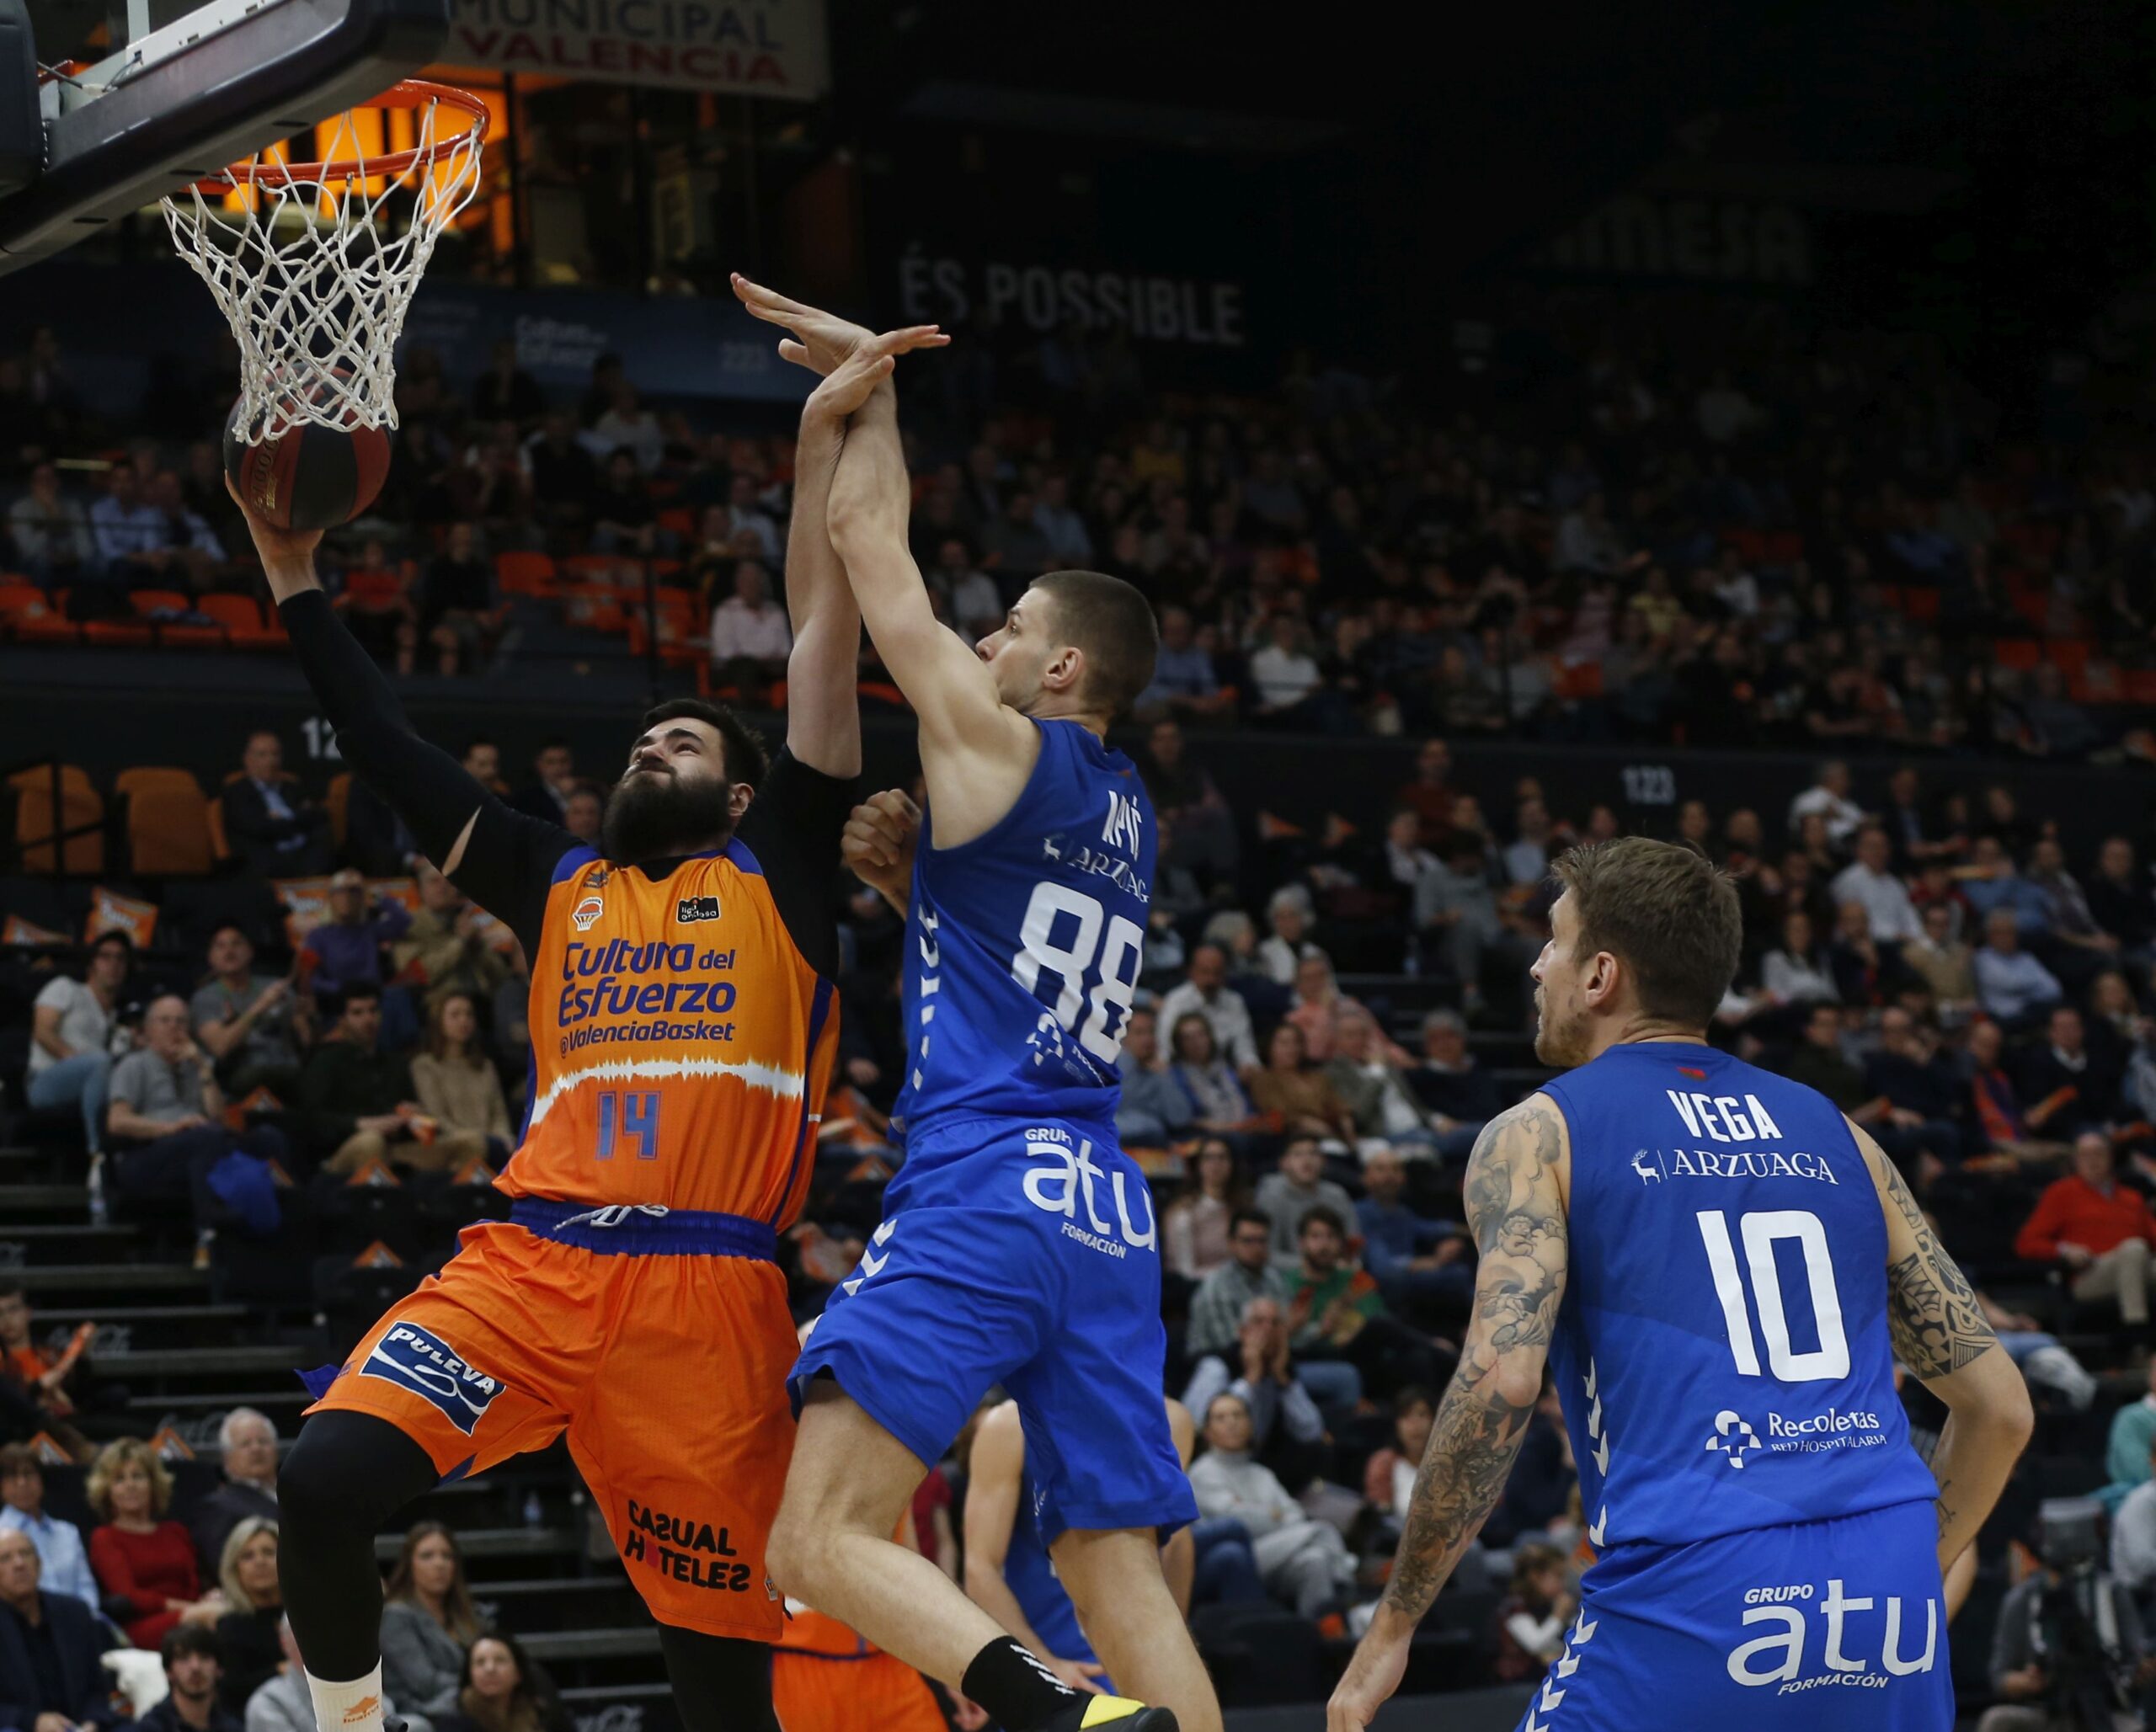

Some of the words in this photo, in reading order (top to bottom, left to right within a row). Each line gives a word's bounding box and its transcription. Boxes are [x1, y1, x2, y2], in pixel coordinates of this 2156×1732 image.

[455, 0, 784, 51] MUNICIPAL
[459, 27, 787, 83] VALENCIA
[899, 240, 969, 322] ÉS
[985, 263, 1246, 346] POSSIBLE
[1620, 765, 1676, 805] 123
[563, 938, 695, 981] Cultura
[698, 948, 736, 969] del
[1011, 881, 1145, 1065] 88
[558, 976, 736, 1028] Esfuerzo
[560, 1019, 735, 1059] @ValenciaBasket
[594, 1090, 661, 1161] 14
[1024, 1128, 1073, 1146] GRUP
[1666, 1090, 1783, 1143] VEGA
[1672, 1149, 1839, 1186] ARZUAGA
[1022, 1138, 1156, 1253] atu
[1060, 1221, 1127, 1260] FORMACIÓN
[1695, 1209, 1851, 1383] 10
[387, 1326, 496, 1396] PULEVA
[1769, 1407, 1880, 1437] Recoletas
[1770, 1441, 1799, 1452] RED
[1799, 1433, 1887, 1453] HOSPITALARIA
[627, 1499, 738, 1557] CASUAL
[1744, 1584, 1815, 1604] GRUPO
[1726, 1579, 1937, 1687] atu
[1777, 1671, 1889, 1697] FORMACIÓN
